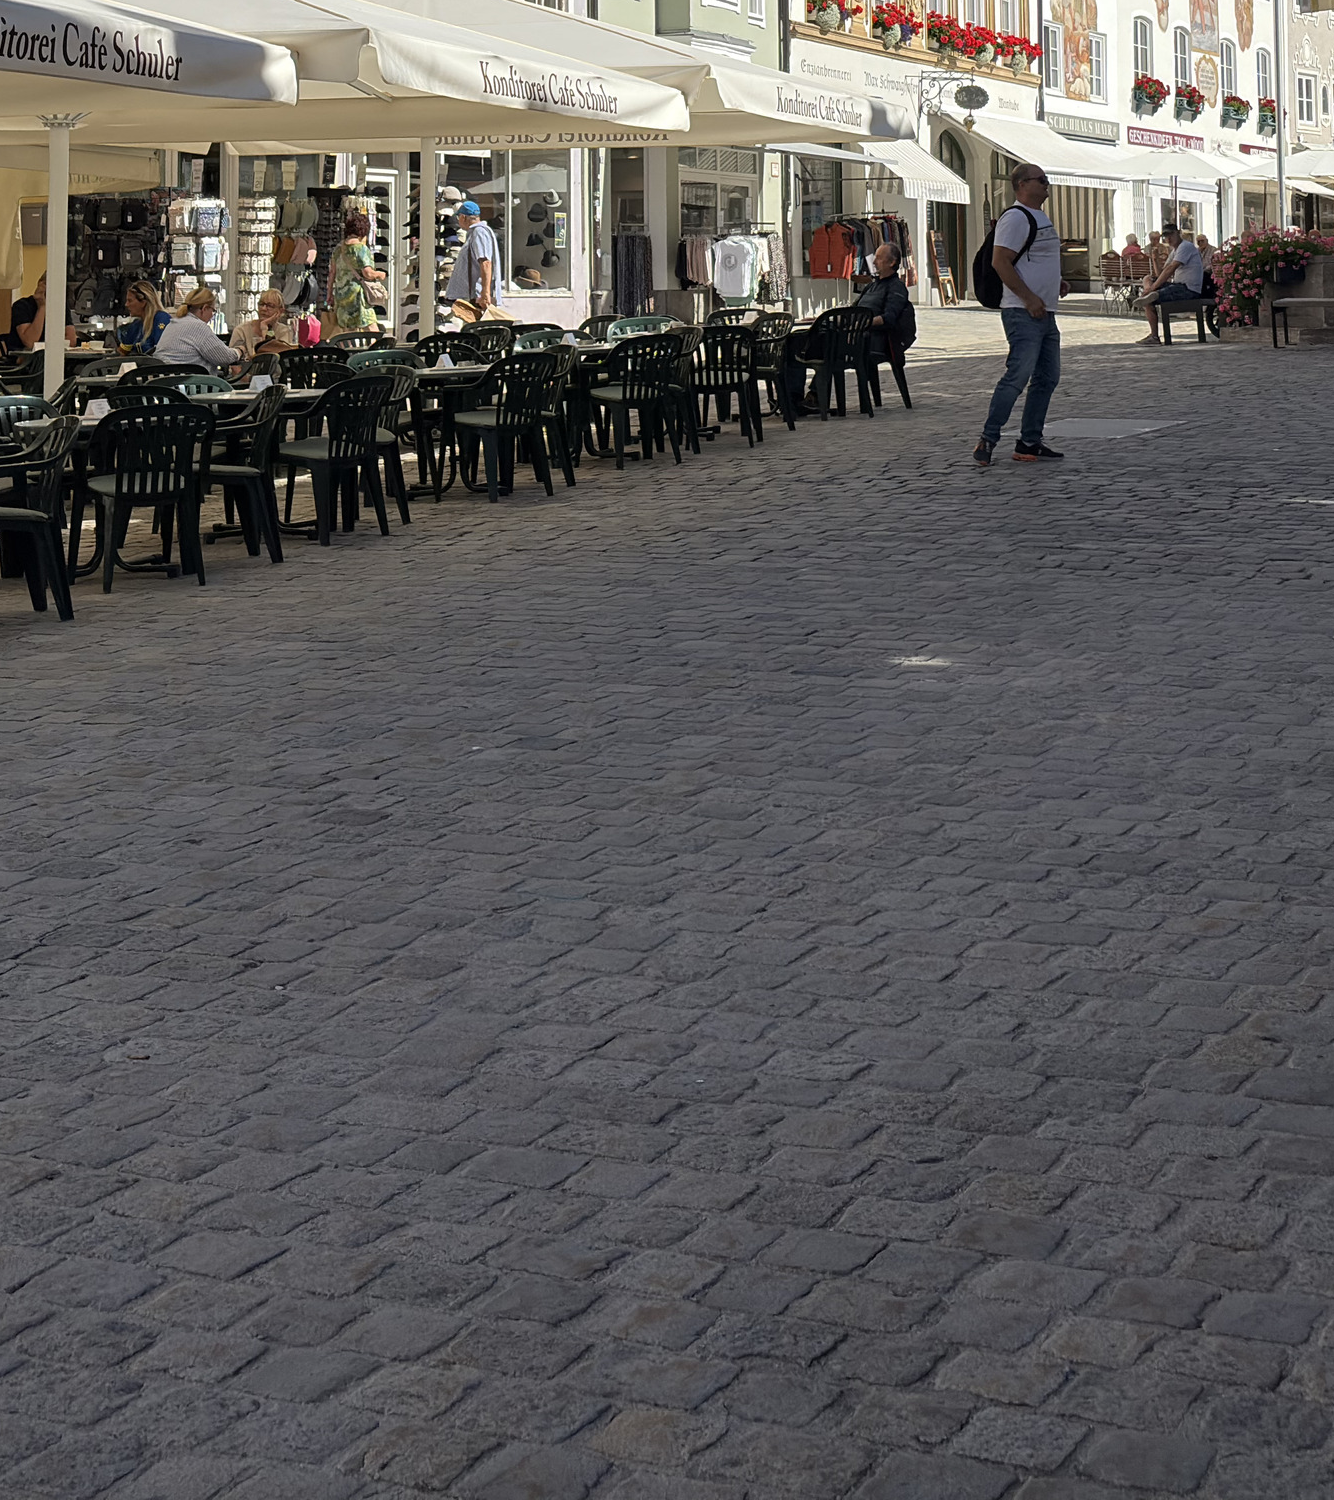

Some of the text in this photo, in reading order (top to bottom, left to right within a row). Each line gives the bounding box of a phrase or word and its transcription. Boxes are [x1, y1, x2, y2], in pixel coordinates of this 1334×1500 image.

[63, 22, 108, 71] Café
[112, 30, 183, 81] Schuler
[479, 60, 618, 115] Konditorei Café Schuler
[776, 86, 863, 128] Konditorei Café Schuler
